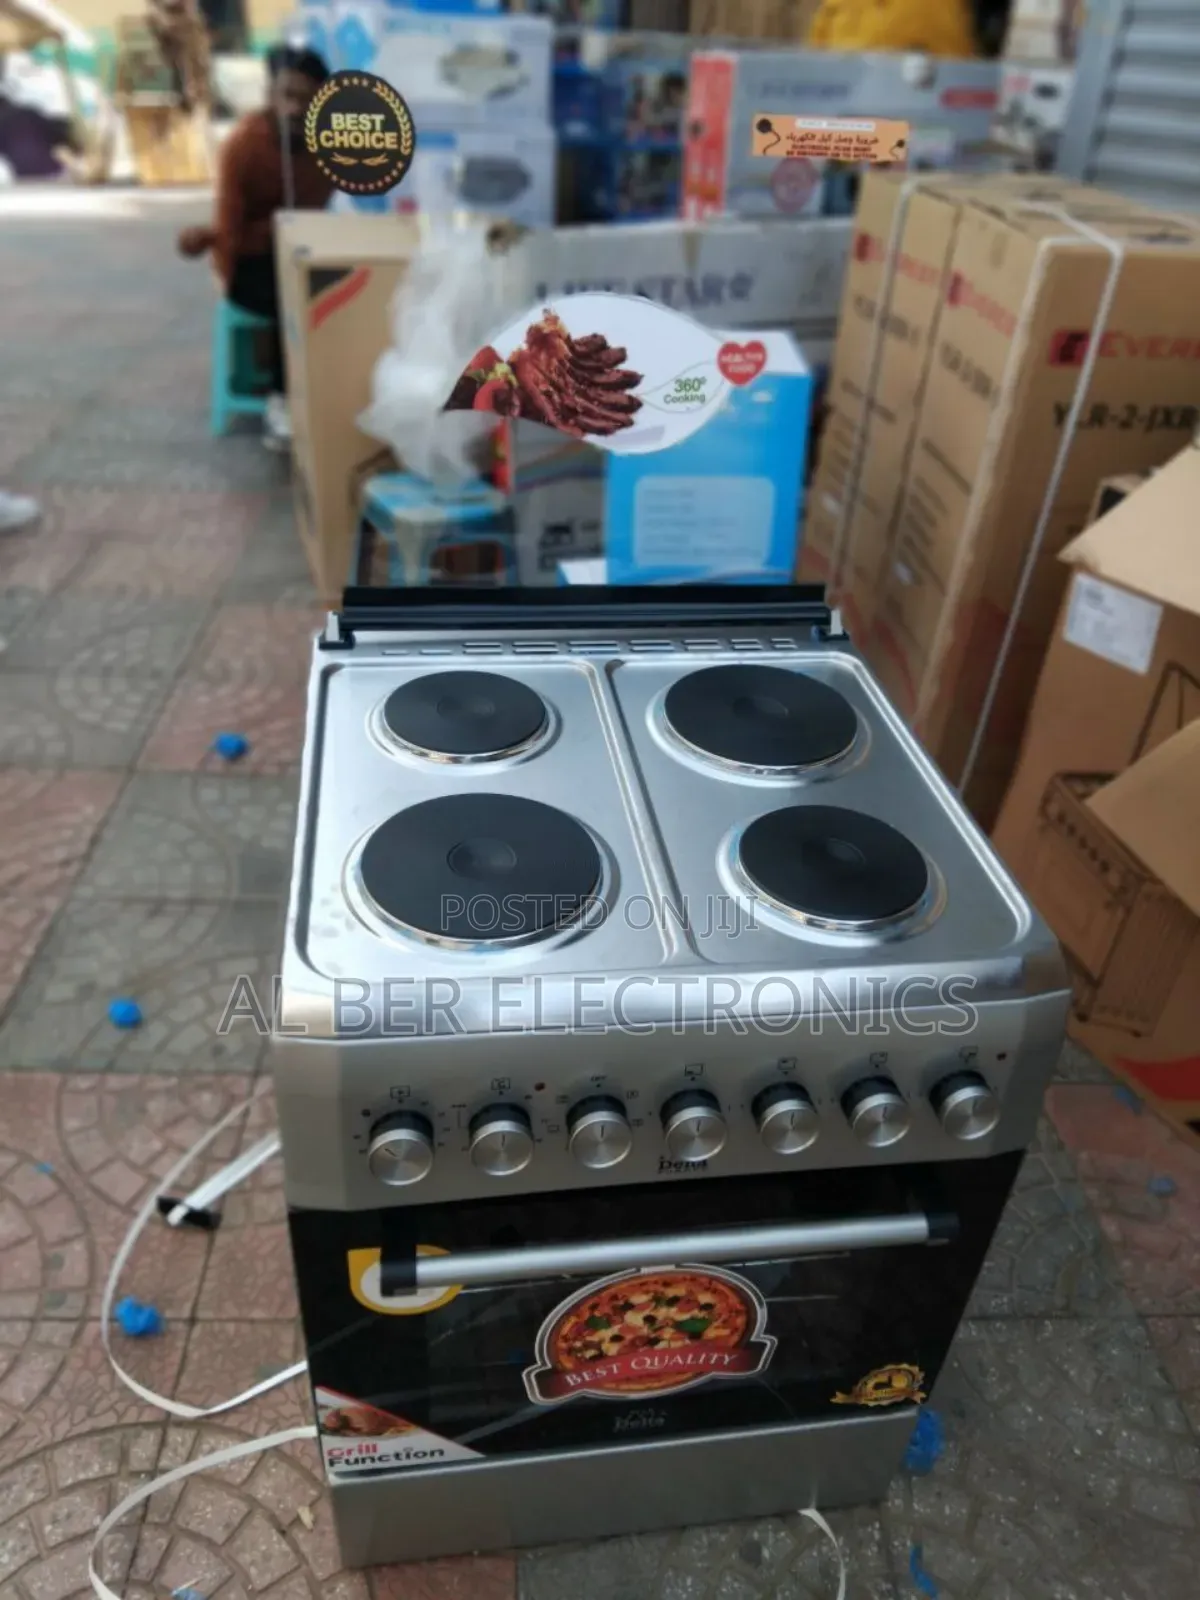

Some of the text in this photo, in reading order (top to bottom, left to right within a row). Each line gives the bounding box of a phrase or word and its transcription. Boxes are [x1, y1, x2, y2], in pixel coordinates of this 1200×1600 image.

[330, 113, 385, 130] BEST
[319, 130, 398, 149] CHOICE
[663, 393, 706, 405] Cooking
[564, 1353, 738, 1387] BEST QUALITY
[327, 1443, 378, 1458] Grill
[328, 1447, 445, 1468] Function
